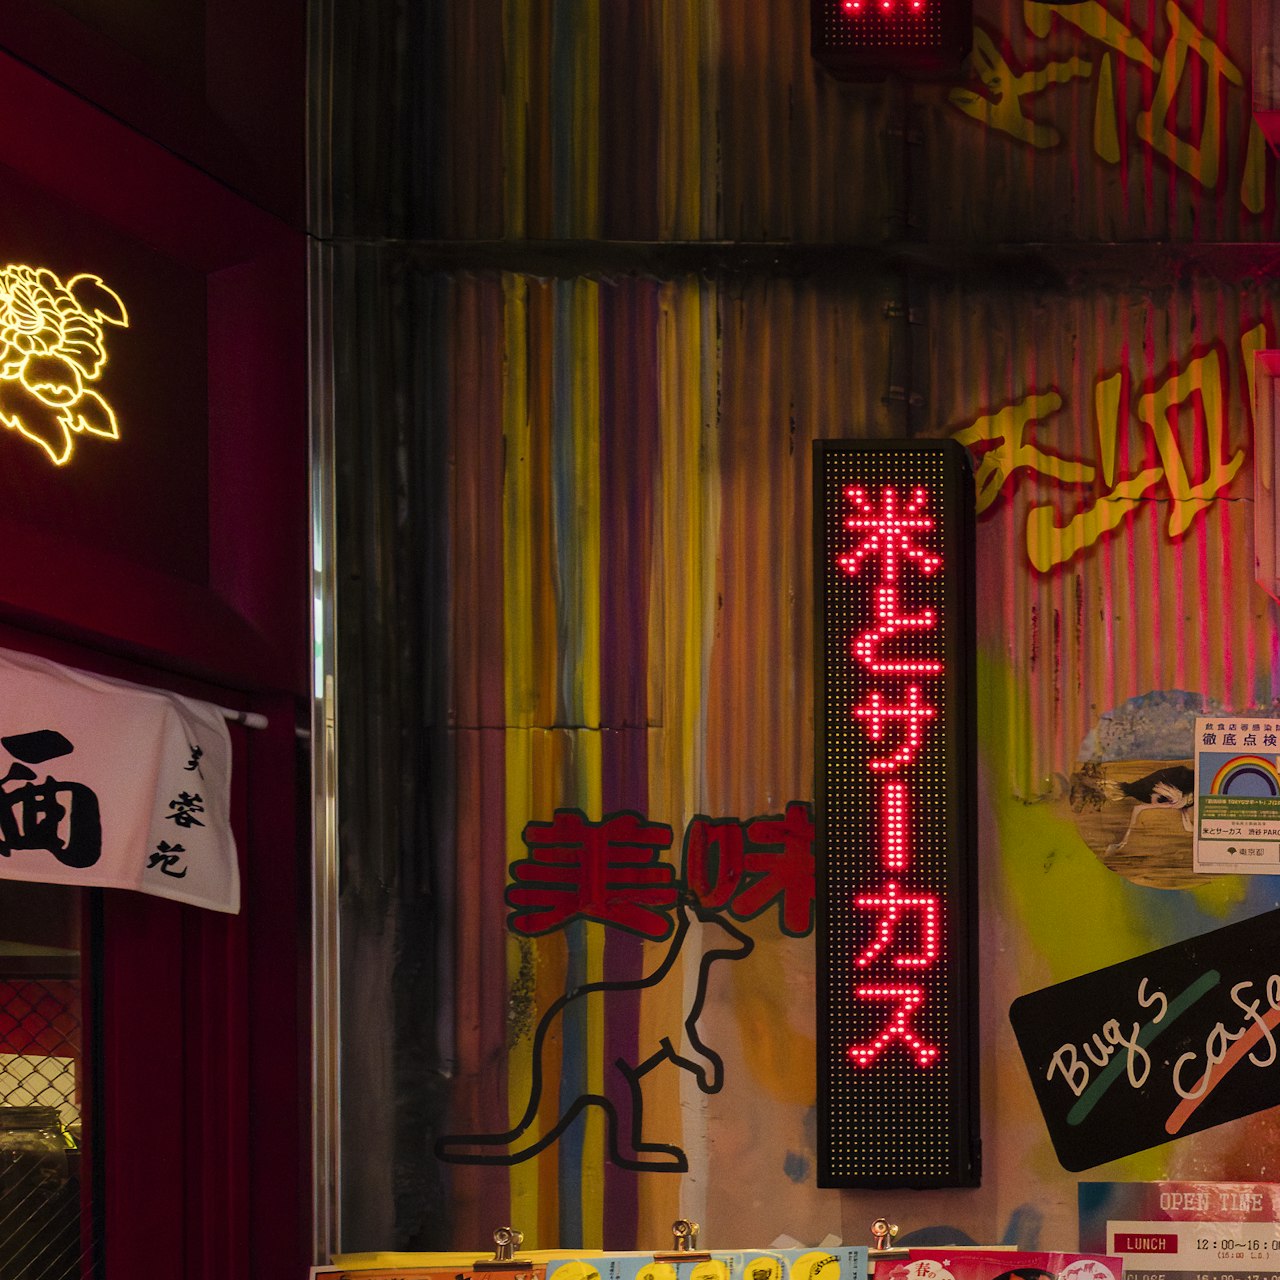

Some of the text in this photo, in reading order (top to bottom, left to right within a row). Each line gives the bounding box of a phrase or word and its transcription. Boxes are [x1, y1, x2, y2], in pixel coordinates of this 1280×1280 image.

[836, 484, 942, 1068] 米とサーカス
[1248, 828, 1262, 836] 渋谷
[1239, 848, 1265, 857] 東京都
[505, 803, 816, 942] 美味
[1046, 976, 1168, 1097] Bugs
[1160, 1193, 1263, 1211] OPEN TIME
[1126, 1238, 1166, 1250] LUNCH
[915, 1261, 937, 1279] 春の
